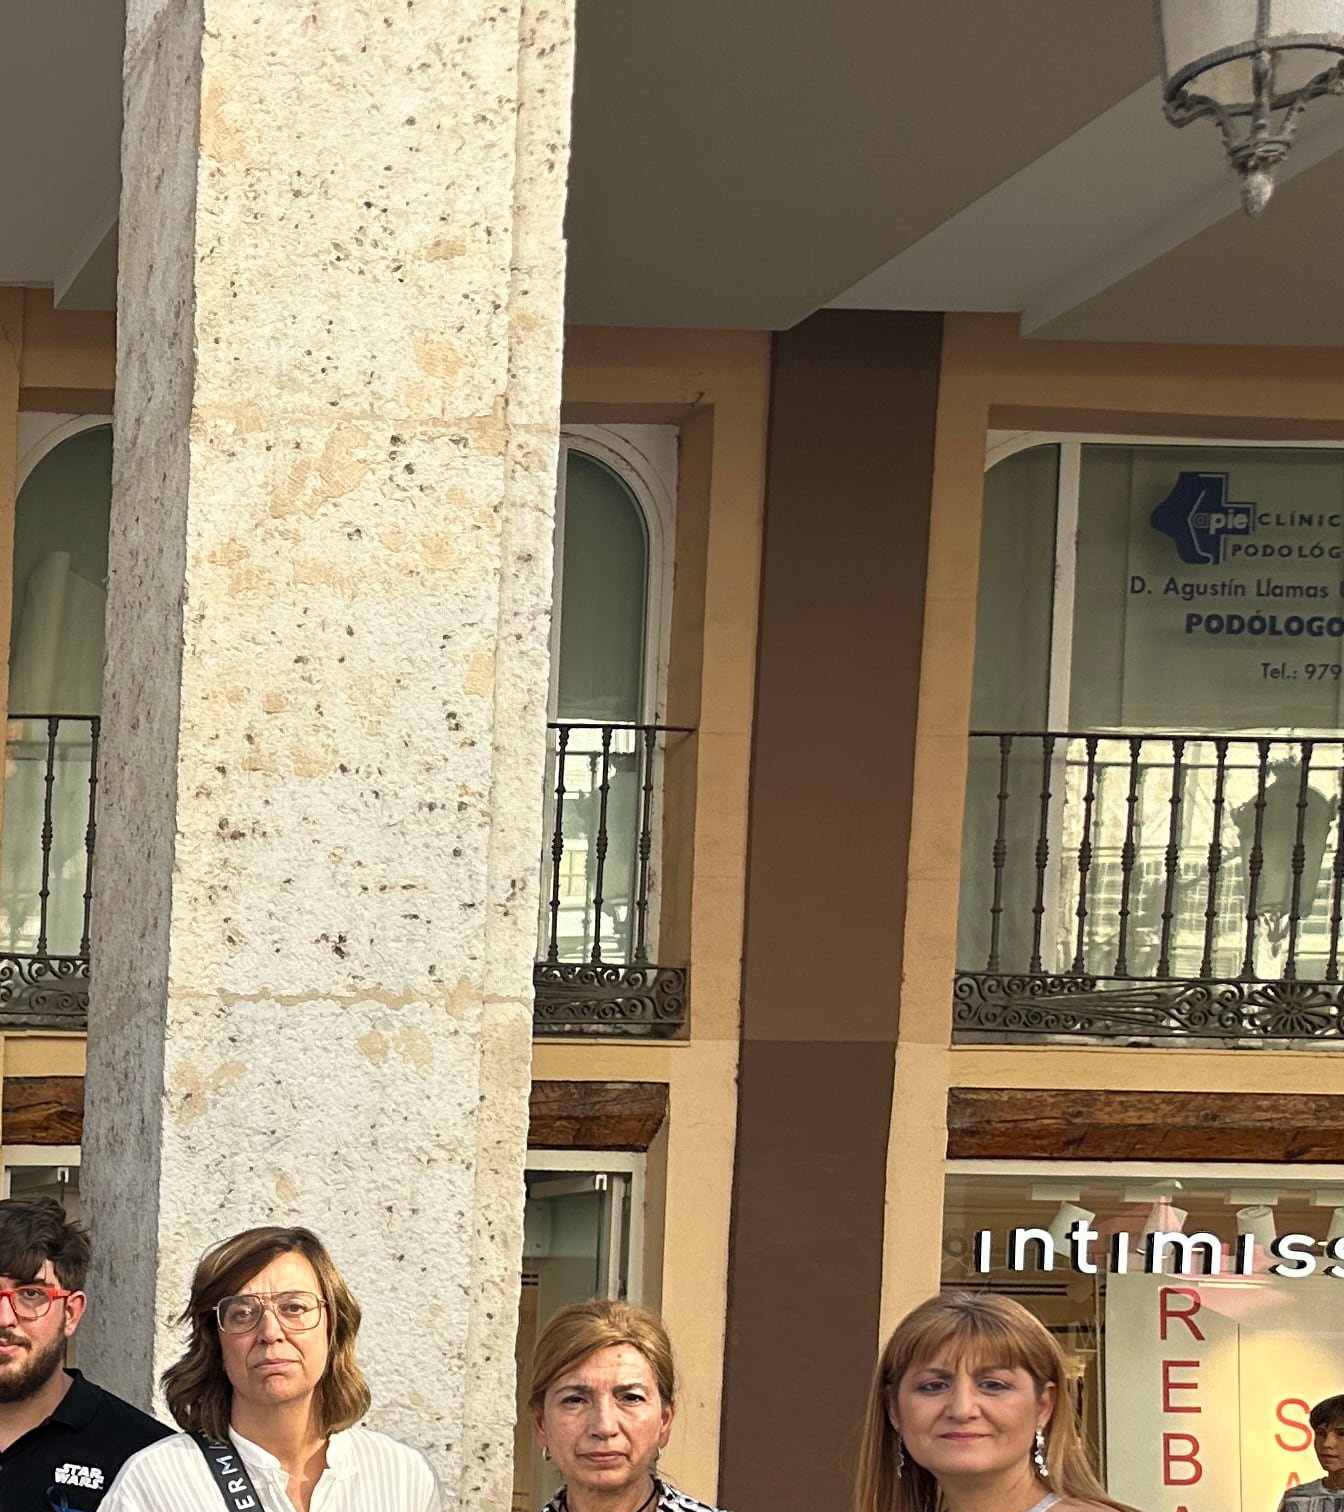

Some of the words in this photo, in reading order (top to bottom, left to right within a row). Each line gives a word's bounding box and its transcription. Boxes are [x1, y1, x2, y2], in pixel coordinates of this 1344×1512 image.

[1130, 575, 1153, 595] D.
[1163, 577, 1246, 601] Agustín
[1256, 578, 1329, 598] Llamas
[1185, 610, 1344, 637] PODÓLOGO
[1304, 663, 1342, 680] 979
[975, 1220, 1344, 1277] intimis
[54, 1472, 105, 1490] WARS
[55, 1463, 103, 1479] STAR
